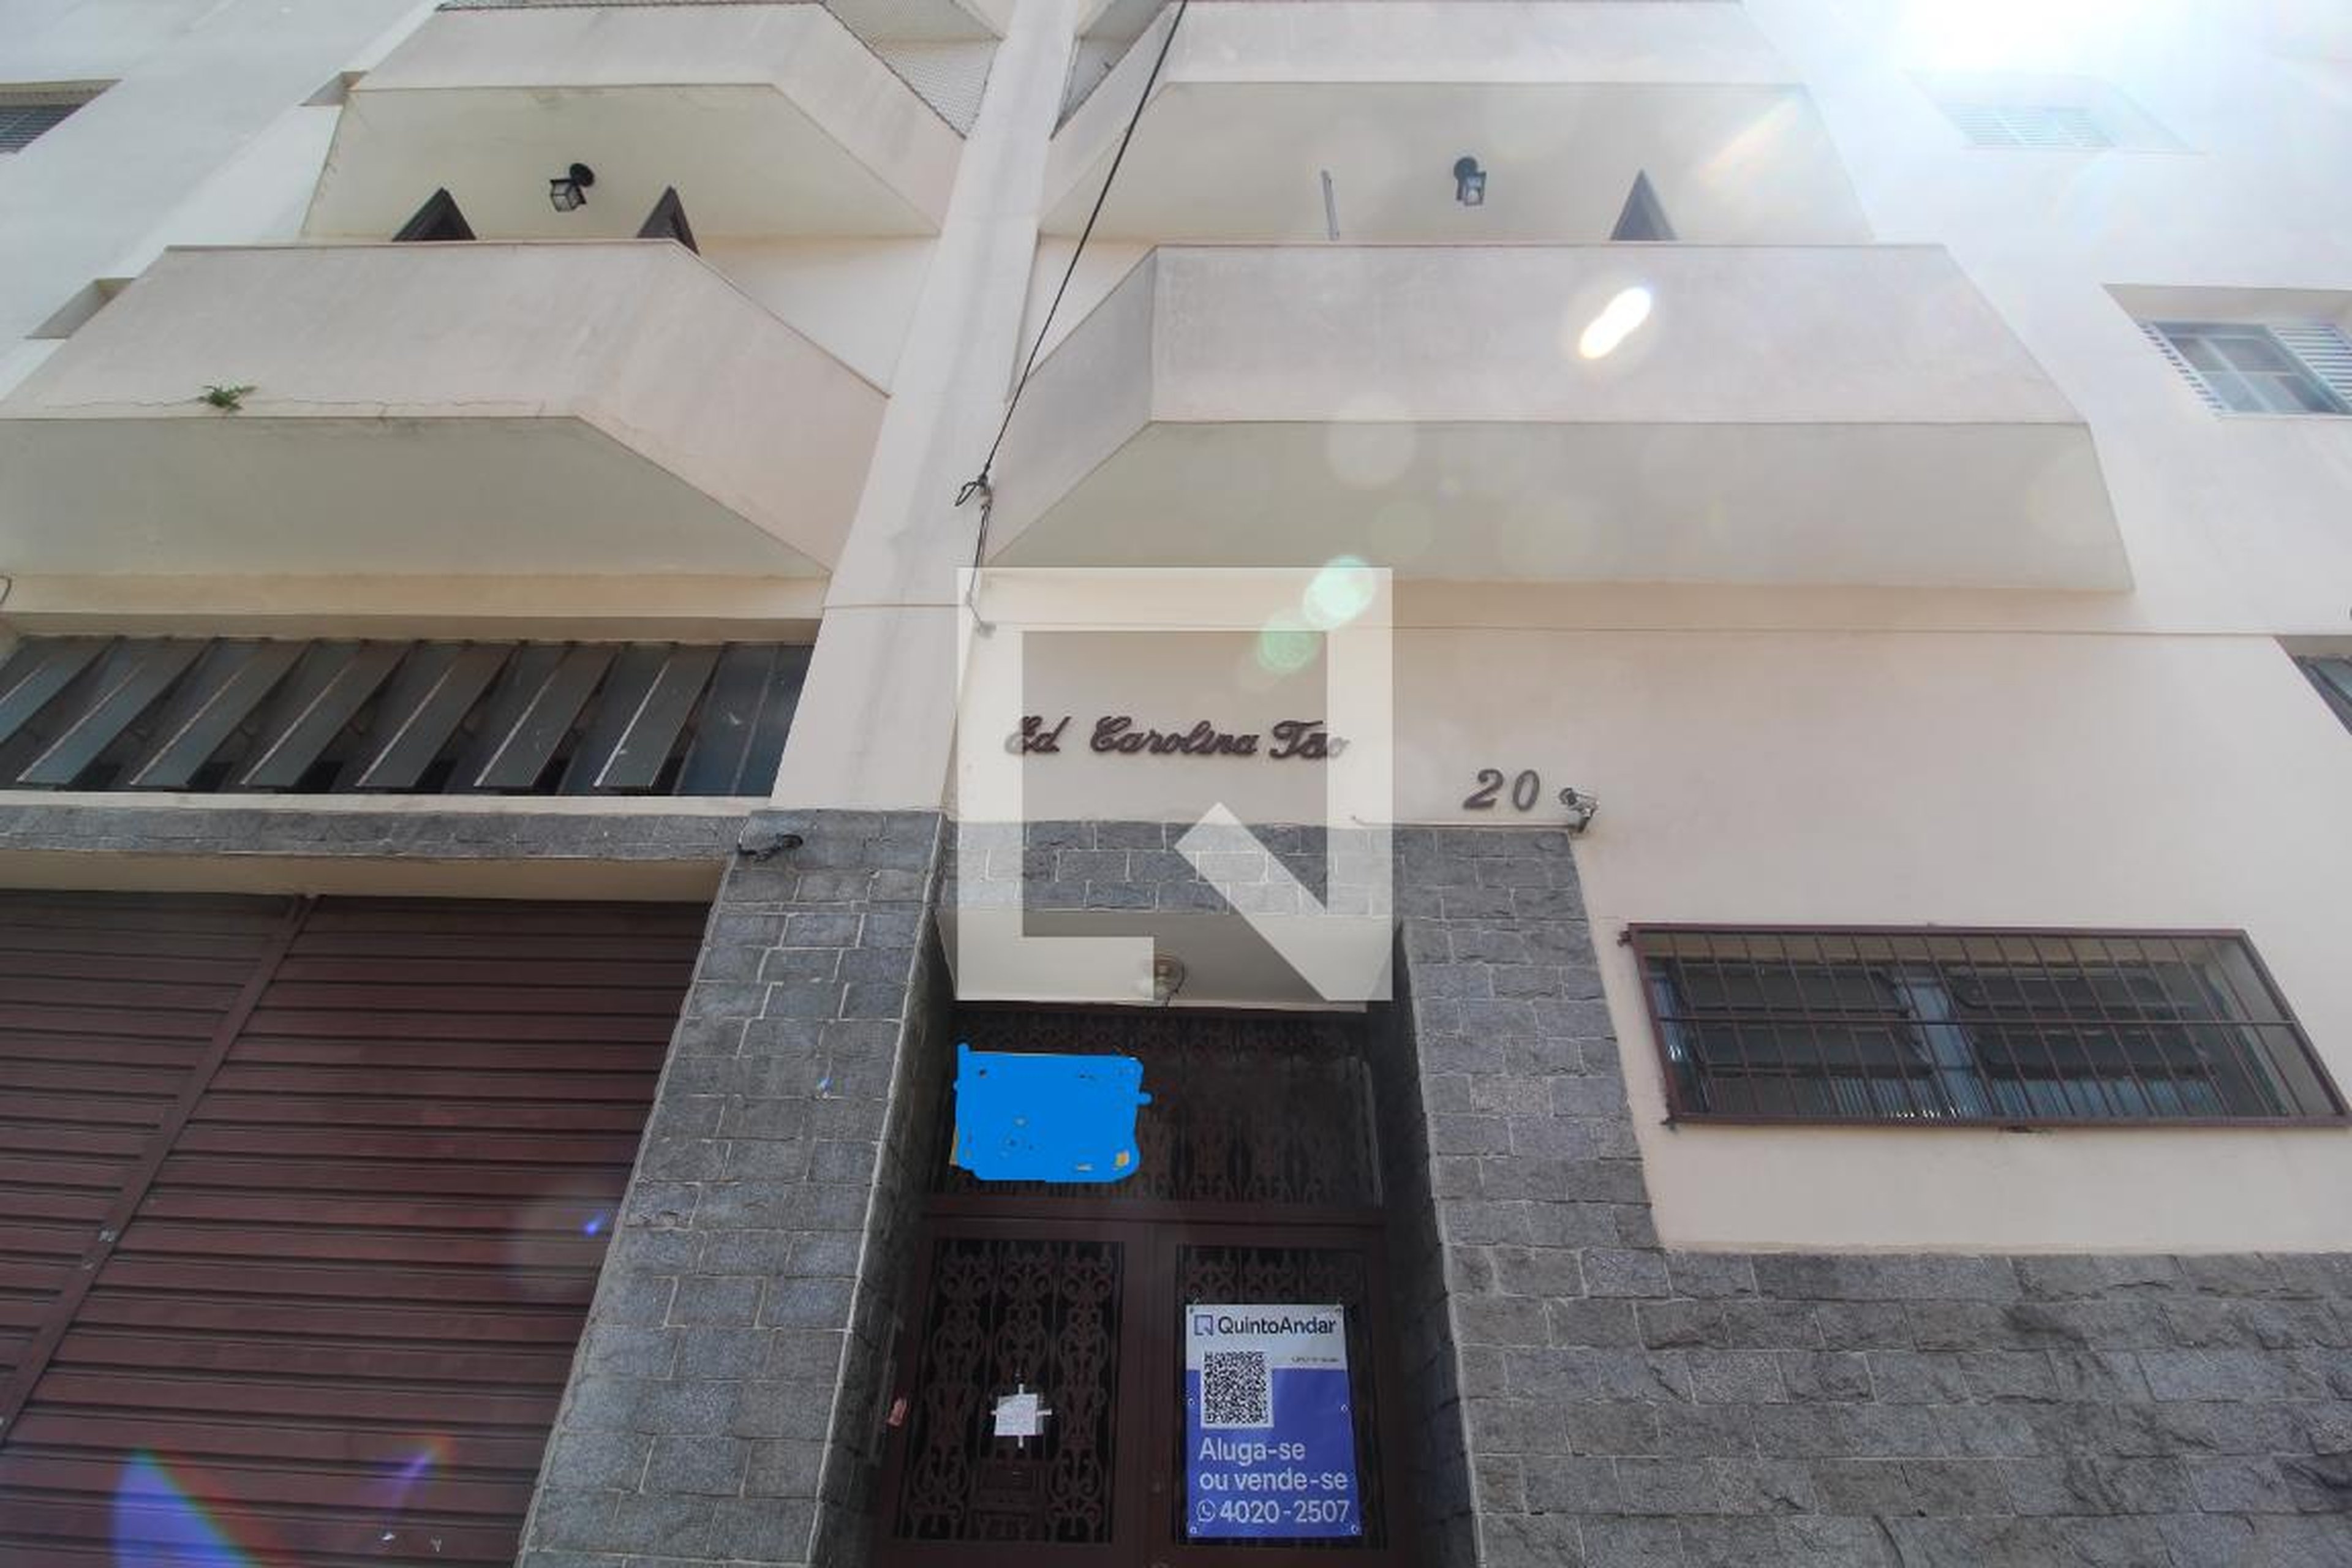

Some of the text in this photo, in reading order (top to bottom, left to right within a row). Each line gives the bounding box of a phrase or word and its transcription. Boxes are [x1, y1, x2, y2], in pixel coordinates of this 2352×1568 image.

[1090, 715, 1260, 757] Carolina
[1463, 769, 1540, 812] 20
[1218, 1316, 1336, 1335] QuintoAndar
[1199, 1437, 1306, 1466] Aluga-se
[1199, 1468, 1348, 1491] ou vende-se
[1219, 1499, 1351, 1523] 4020-2507
